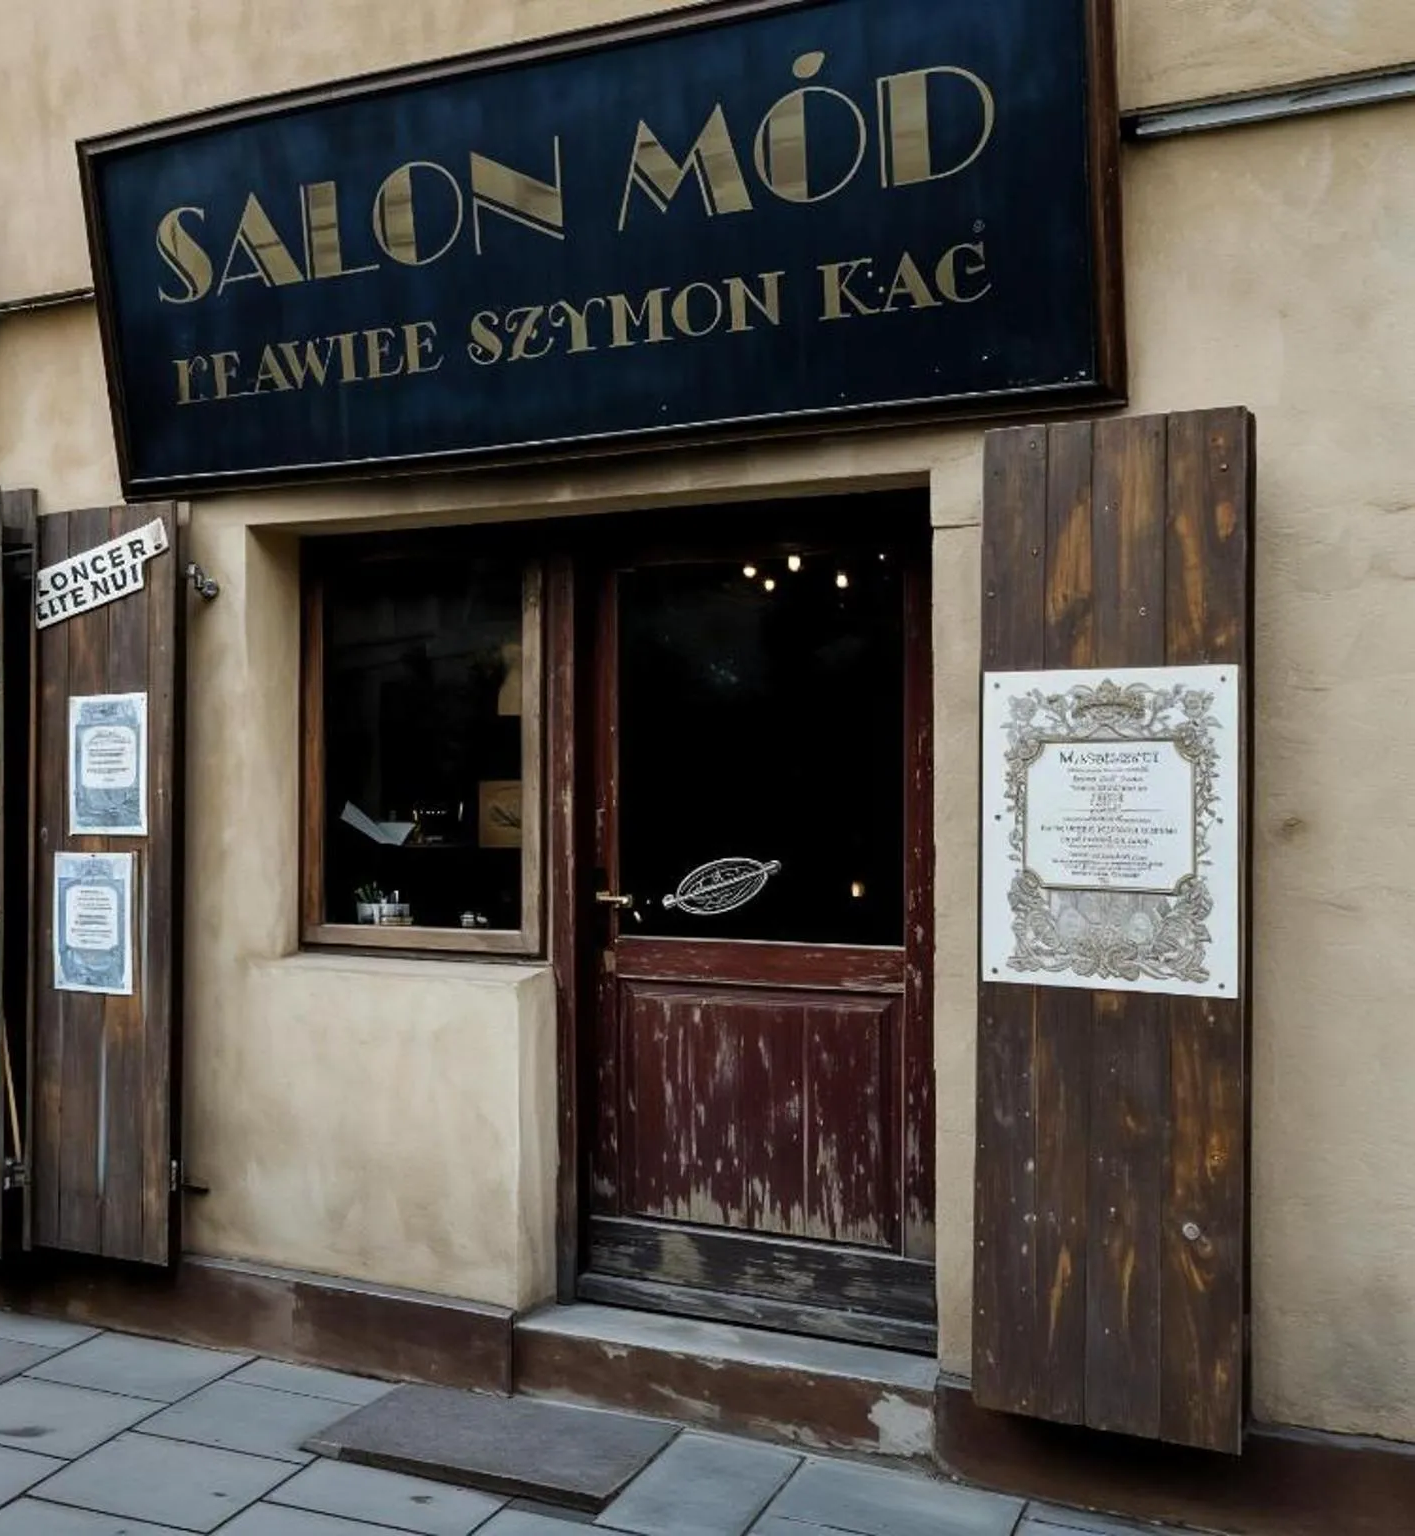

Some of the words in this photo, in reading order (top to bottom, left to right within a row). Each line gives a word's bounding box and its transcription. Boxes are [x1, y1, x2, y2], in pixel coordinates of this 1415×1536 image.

[156, 135, 565, 304] SALON
[618, 51, 995, 232] MÓD
[467, 271, 785, 365] SZYMON
